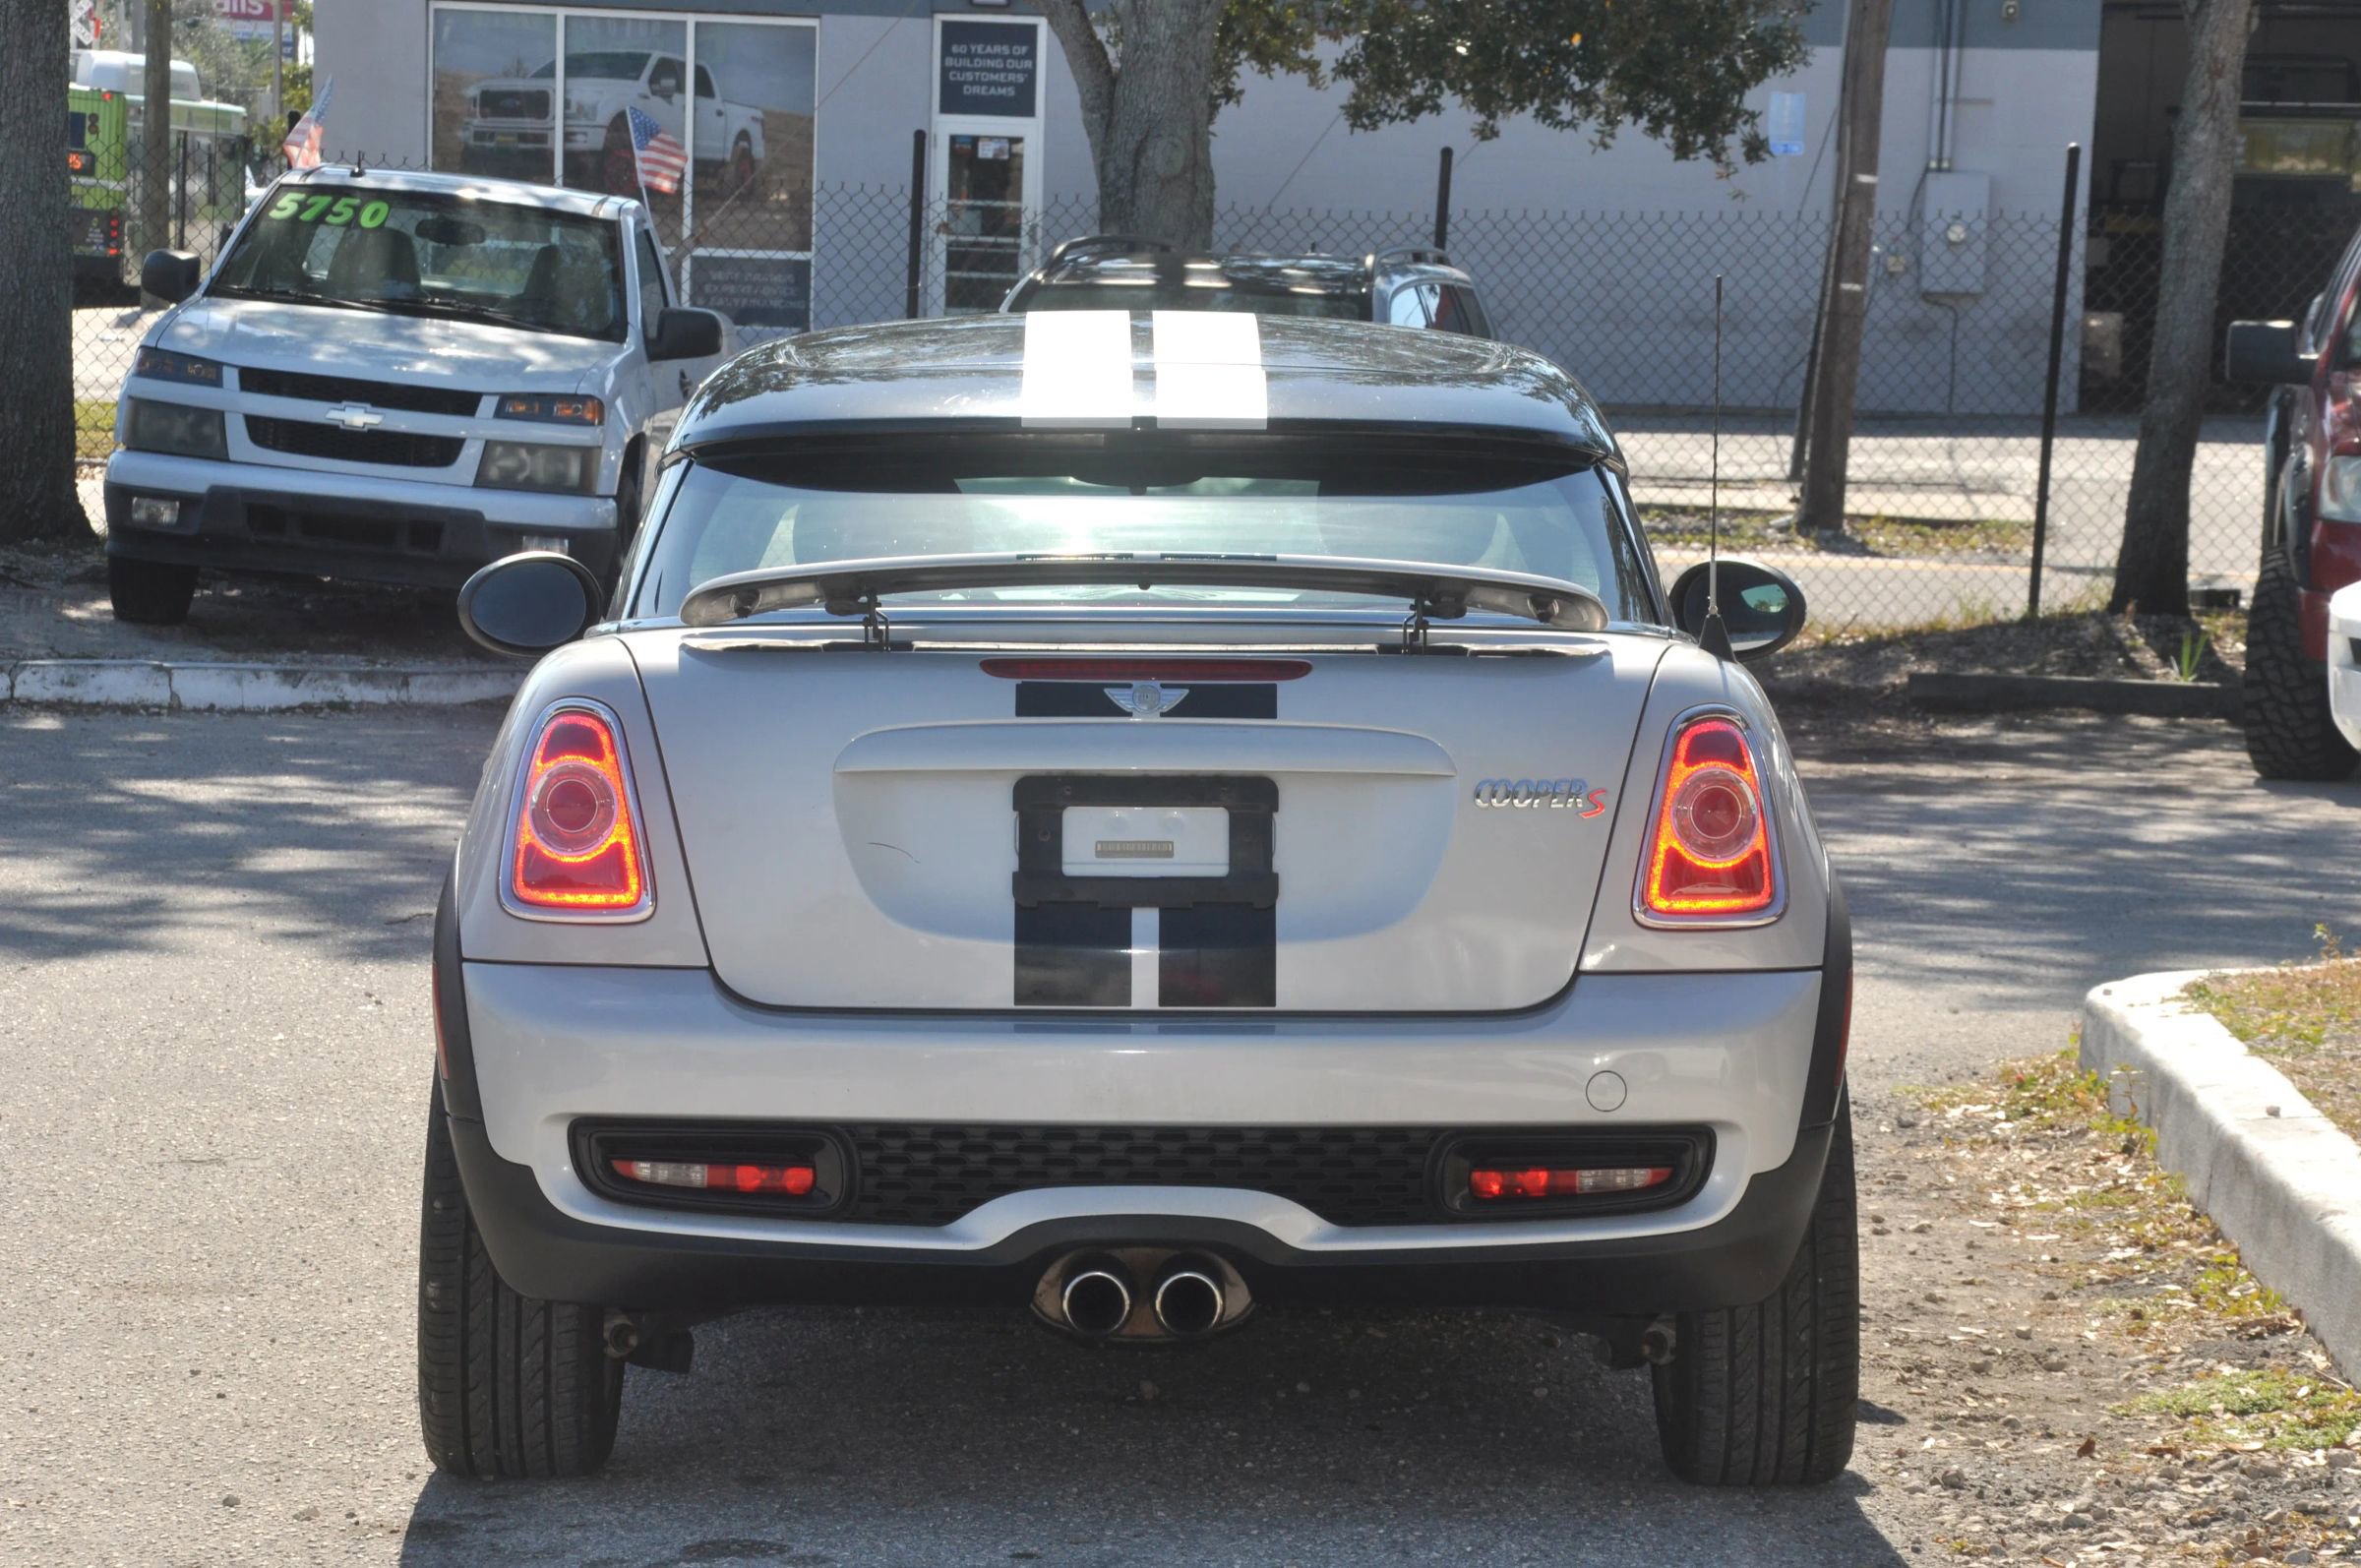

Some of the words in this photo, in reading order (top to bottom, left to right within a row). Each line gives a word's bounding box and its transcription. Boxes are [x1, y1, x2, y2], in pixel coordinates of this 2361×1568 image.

[951, 43, 967, 54] 60
[969, 44, 1010, 55] YEARS
[1011, 45, 1029, 56] OF
[944, 56, 1004, 69] BUILDING
[1005, 59, 1033, 70] OUR
[948, 71, 1029, 84] CUSTOMERS'
[962, 85, 1016, 97] DREAMS
[268, 192, 391, 228] 5750
[1474, 778, 1589, 809] COOPER
[1576, 788, 1606, 818] S
